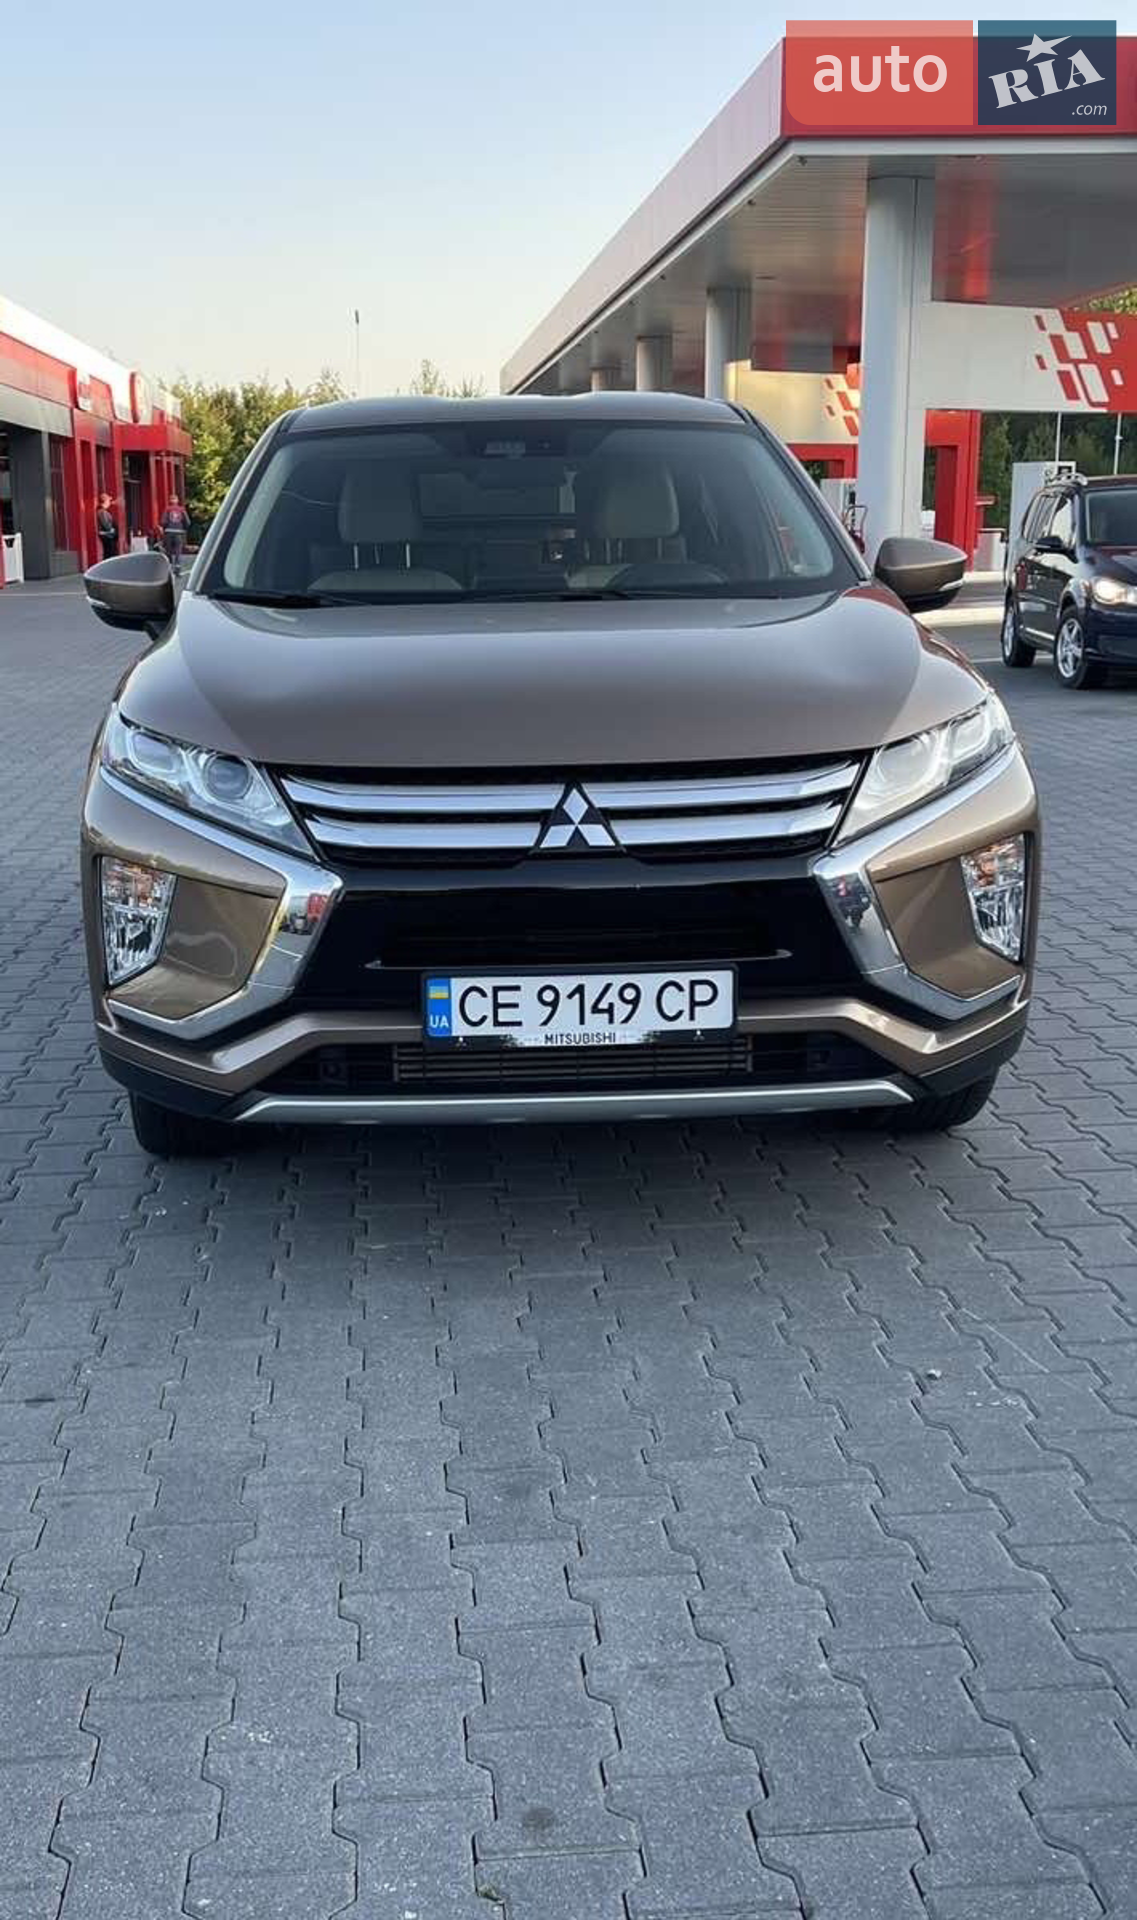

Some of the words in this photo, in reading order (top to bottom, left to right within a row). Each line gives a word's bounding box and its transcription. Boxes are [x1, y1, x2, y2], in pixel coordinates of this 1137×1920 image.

[459, 985, 523, 1028] CE
[536, 982, 642, 1027] 9149
[655, 979, 719, 1023] CP
[429, 1014, 450, 1029] UA
[544, 1032, 616, 1045] MITSUBISHI
